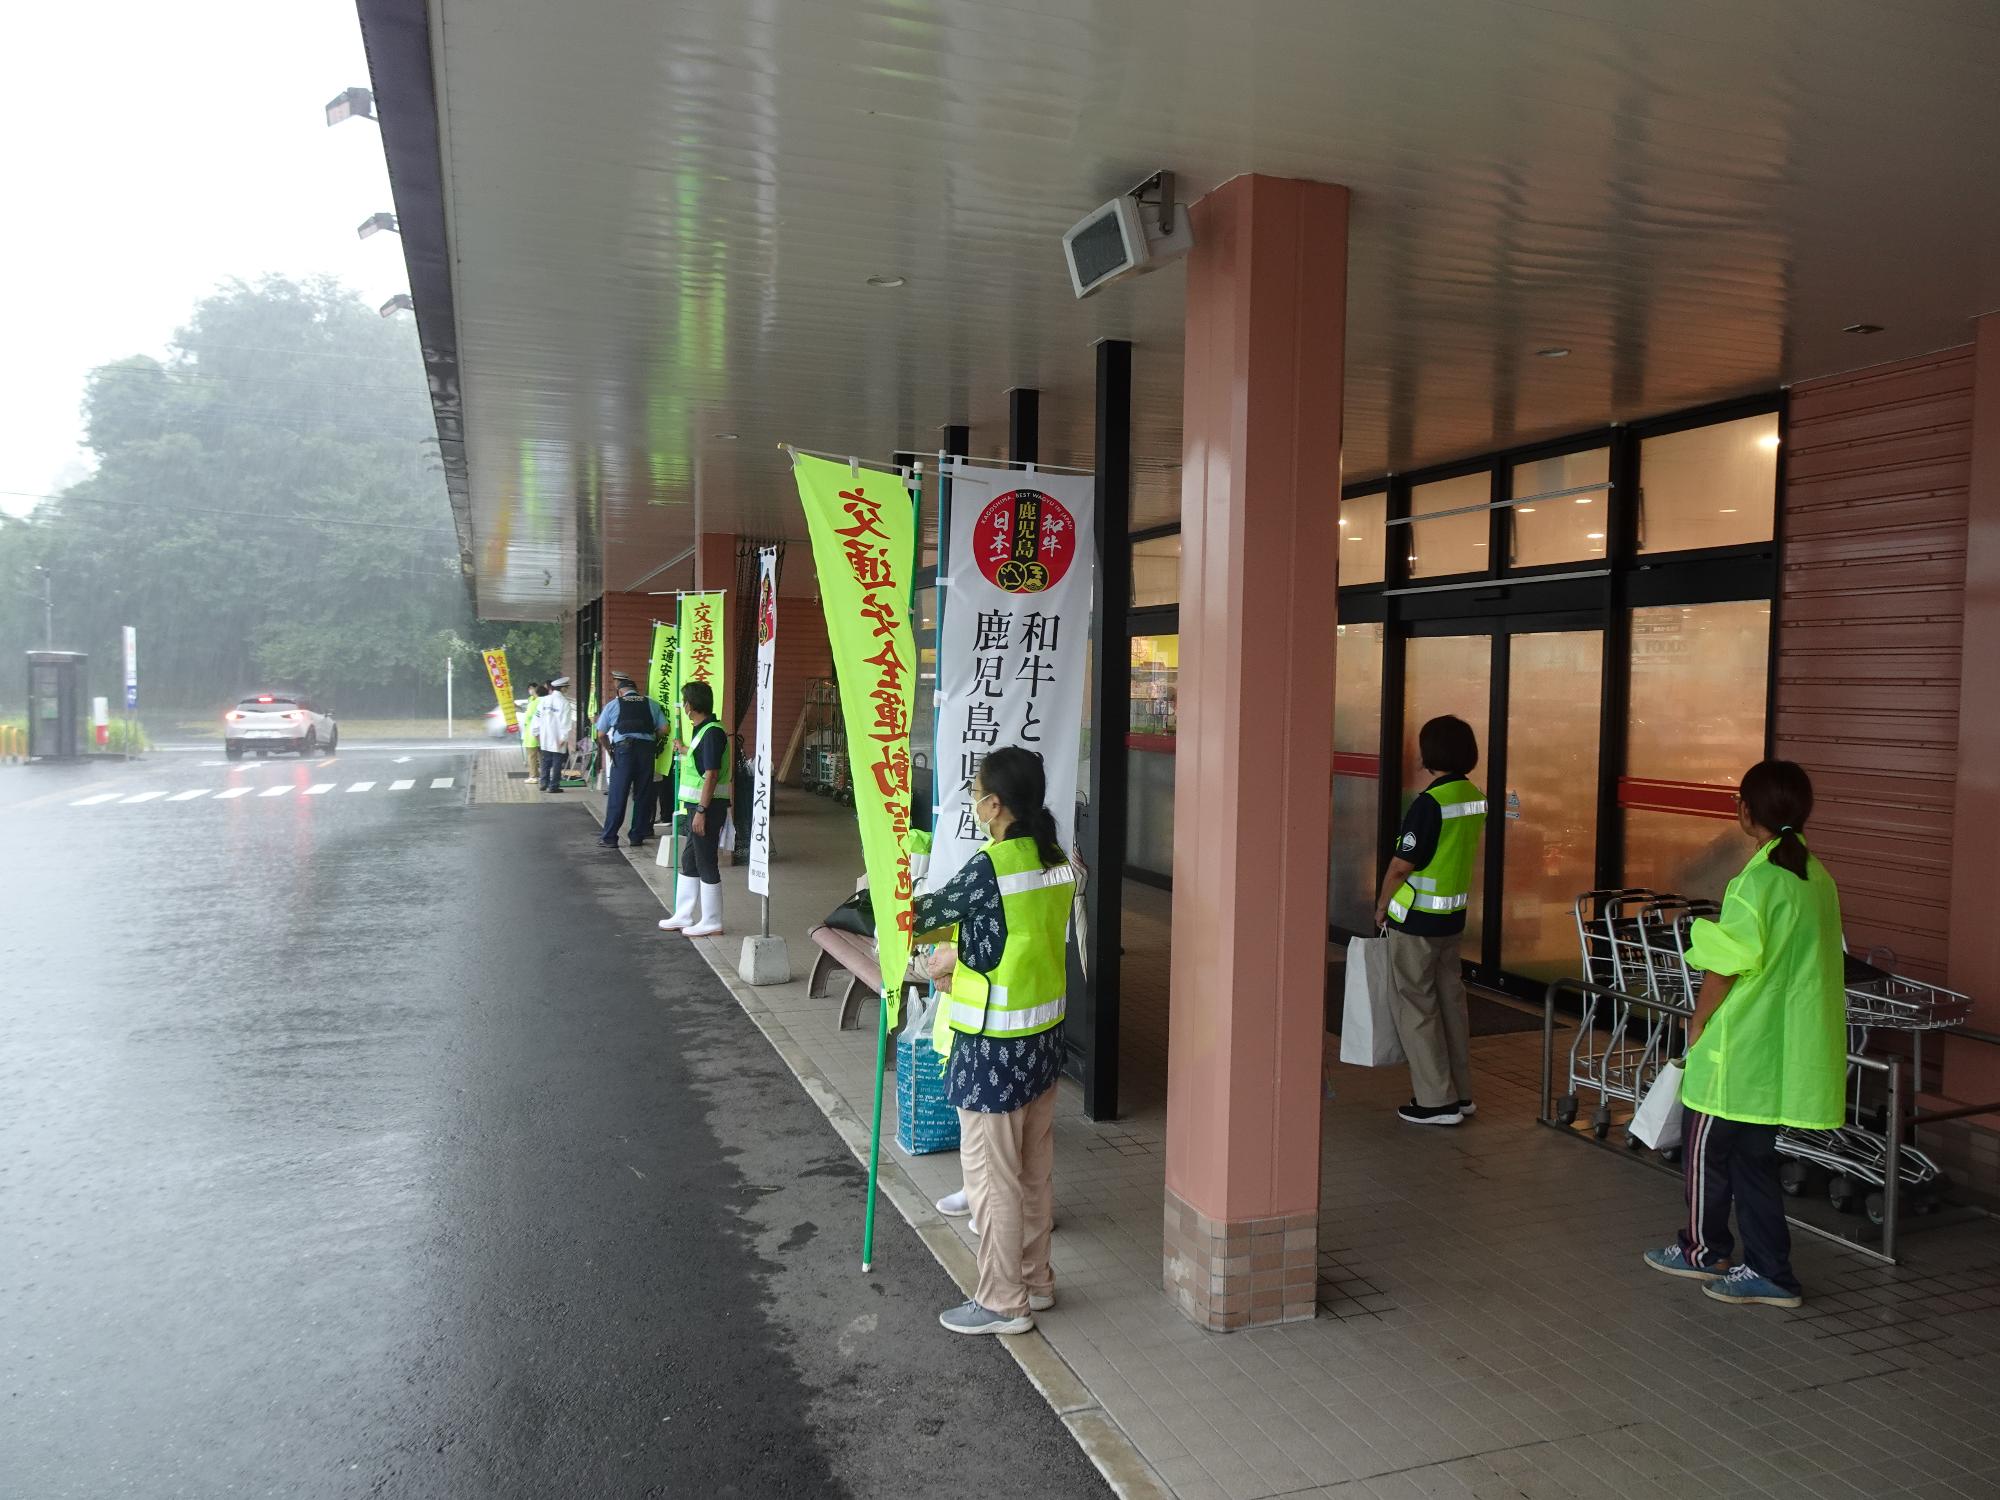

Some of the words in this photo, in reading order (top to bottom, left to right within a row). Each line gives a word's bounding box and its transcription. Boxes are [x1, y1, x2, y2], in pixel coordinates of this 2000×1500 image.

[1032, 493, 1055, 507] WAGYU
[989, 510, 1010, 562] 日本一
[1015, 501, 1037, 559] 鹿児島
[1041, 513, 1065, 558] 和牛
[690, 602, 715, 685] 交通安全
[655, 634, 678, 745] 交通安全運動
[1015, 611, 1061, 750] 和牛と
